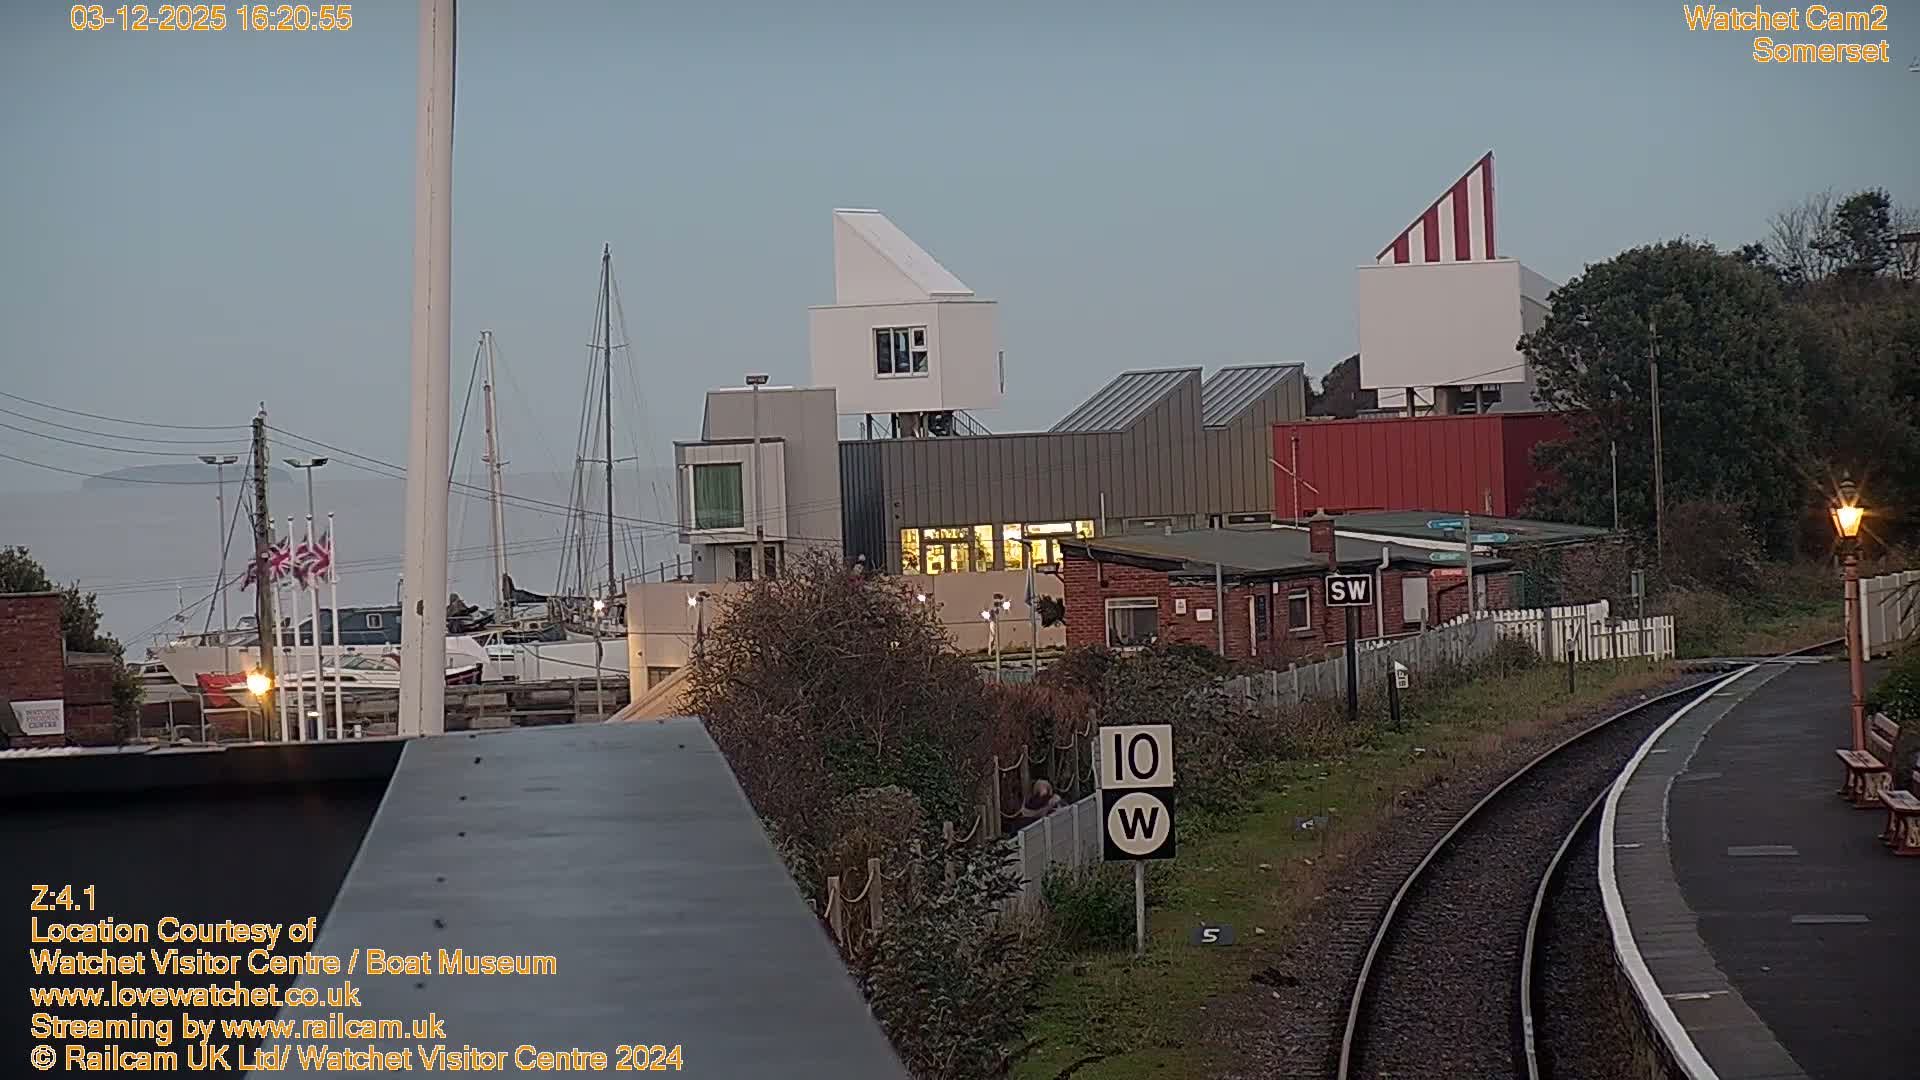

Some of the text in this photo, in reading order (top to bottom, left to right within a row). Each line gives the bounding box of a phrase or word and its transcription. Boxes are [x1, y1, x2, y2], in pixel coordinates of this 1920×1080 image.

[1331, 580, 1366, 601] SW
[1114, 733, 1159, 781] 10
[1118, 807, 1159, 840] W
